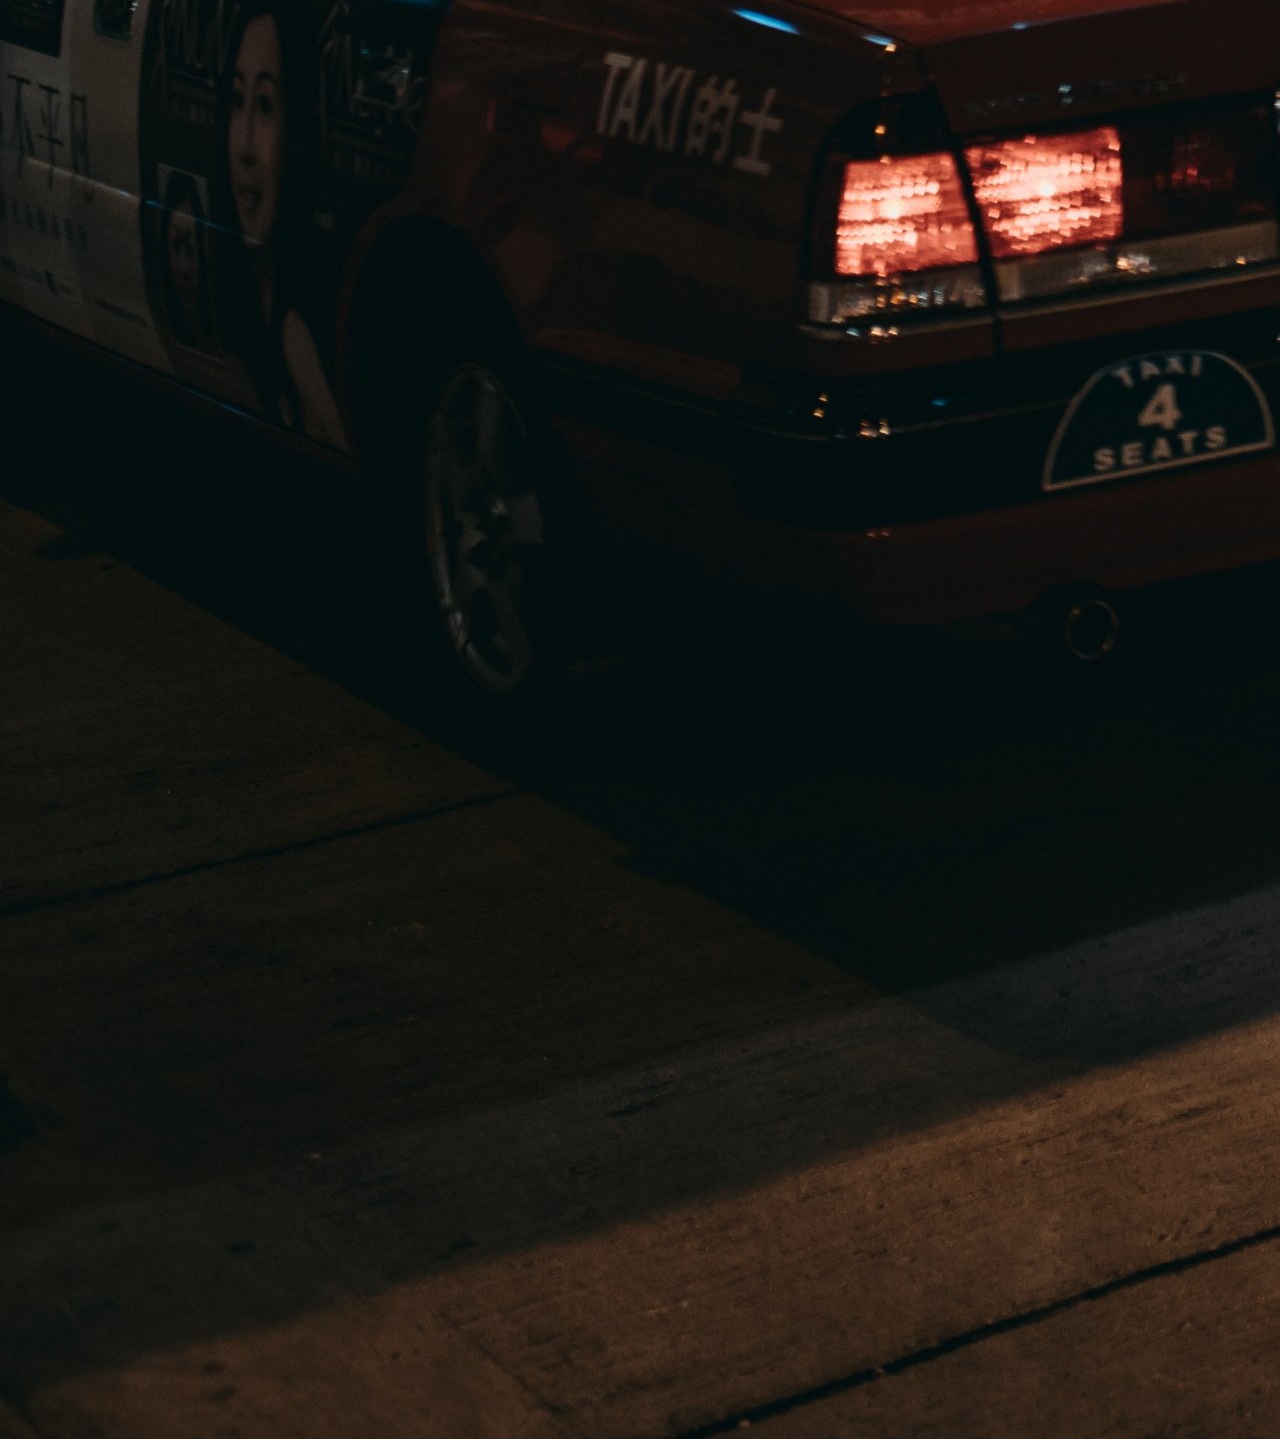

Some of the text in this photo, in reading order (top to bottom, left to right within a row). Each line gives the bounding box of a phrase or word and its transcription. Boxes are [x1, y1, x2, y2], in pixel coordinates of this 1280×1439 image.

[1110, 349, 1204, 390] TAXI
[1138, 382, 1184, 435] 4
[1093, 425, 1232, 472] SEATS
